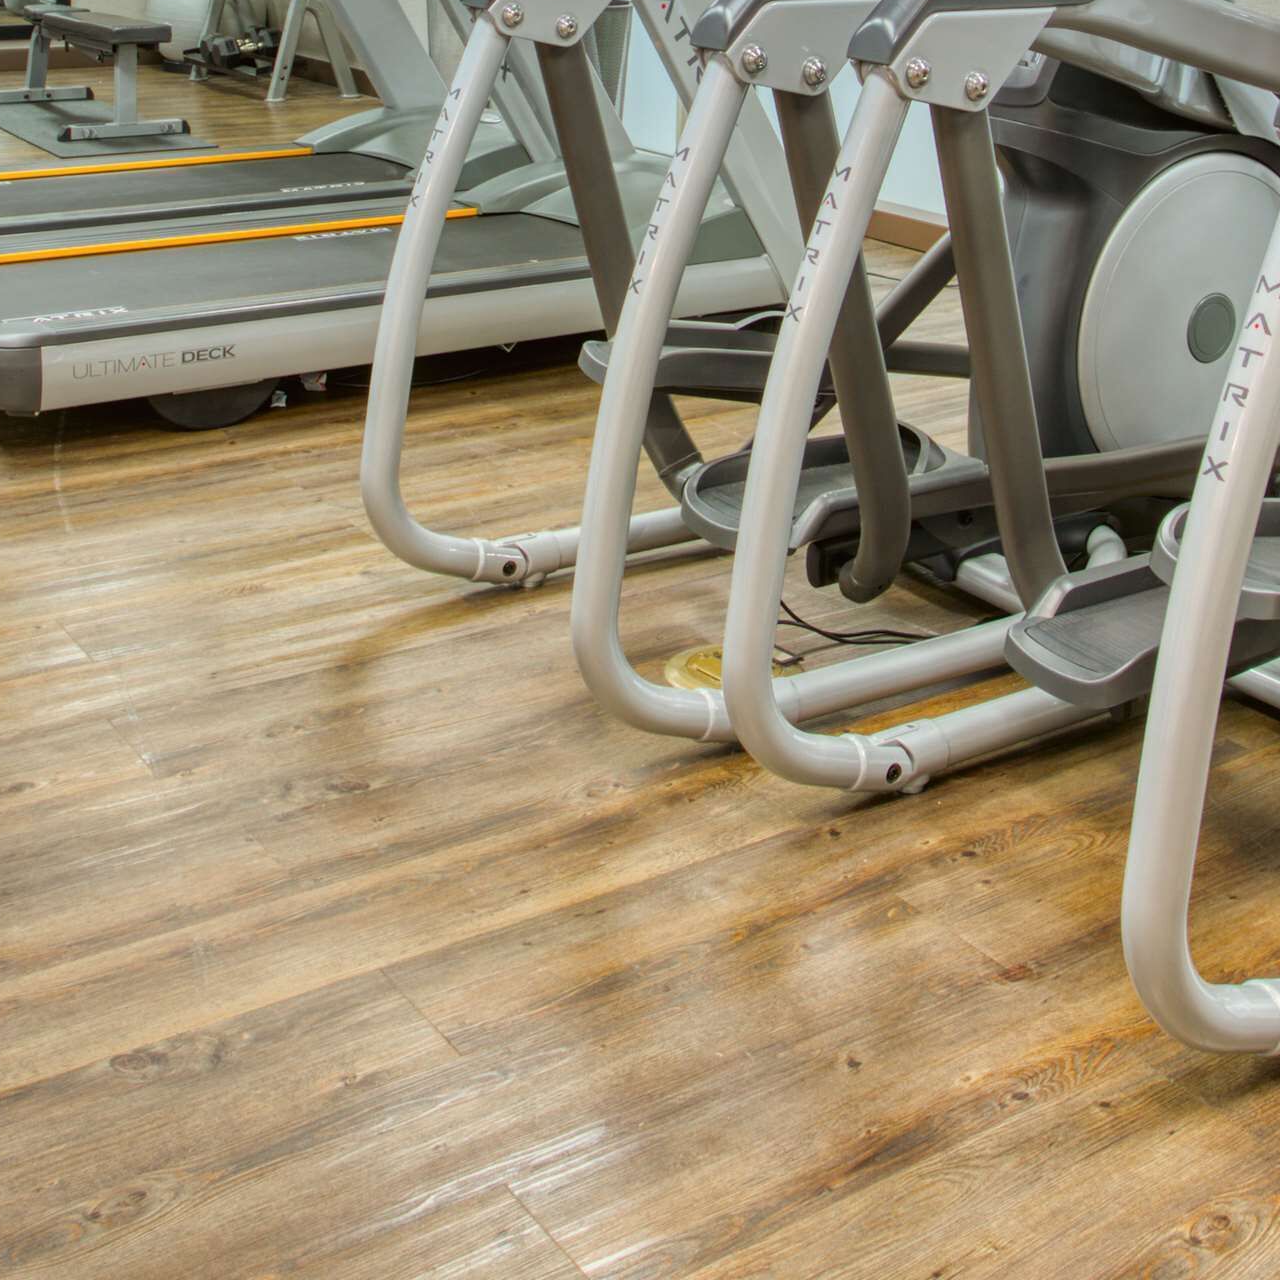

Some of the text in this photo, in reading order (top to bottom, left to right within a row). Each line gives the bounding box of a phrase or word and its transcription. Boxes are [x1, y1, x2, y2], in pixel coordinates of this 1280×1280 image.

[408, 86, 461, 209] MATRIX
[630, 146, 691, 295] MATRIX
[786, 165, 852, 324] MATRIX
[28, 304, 130, 324] ATRIX
[72, 343, 238, 381] ULTIMATE DECK
